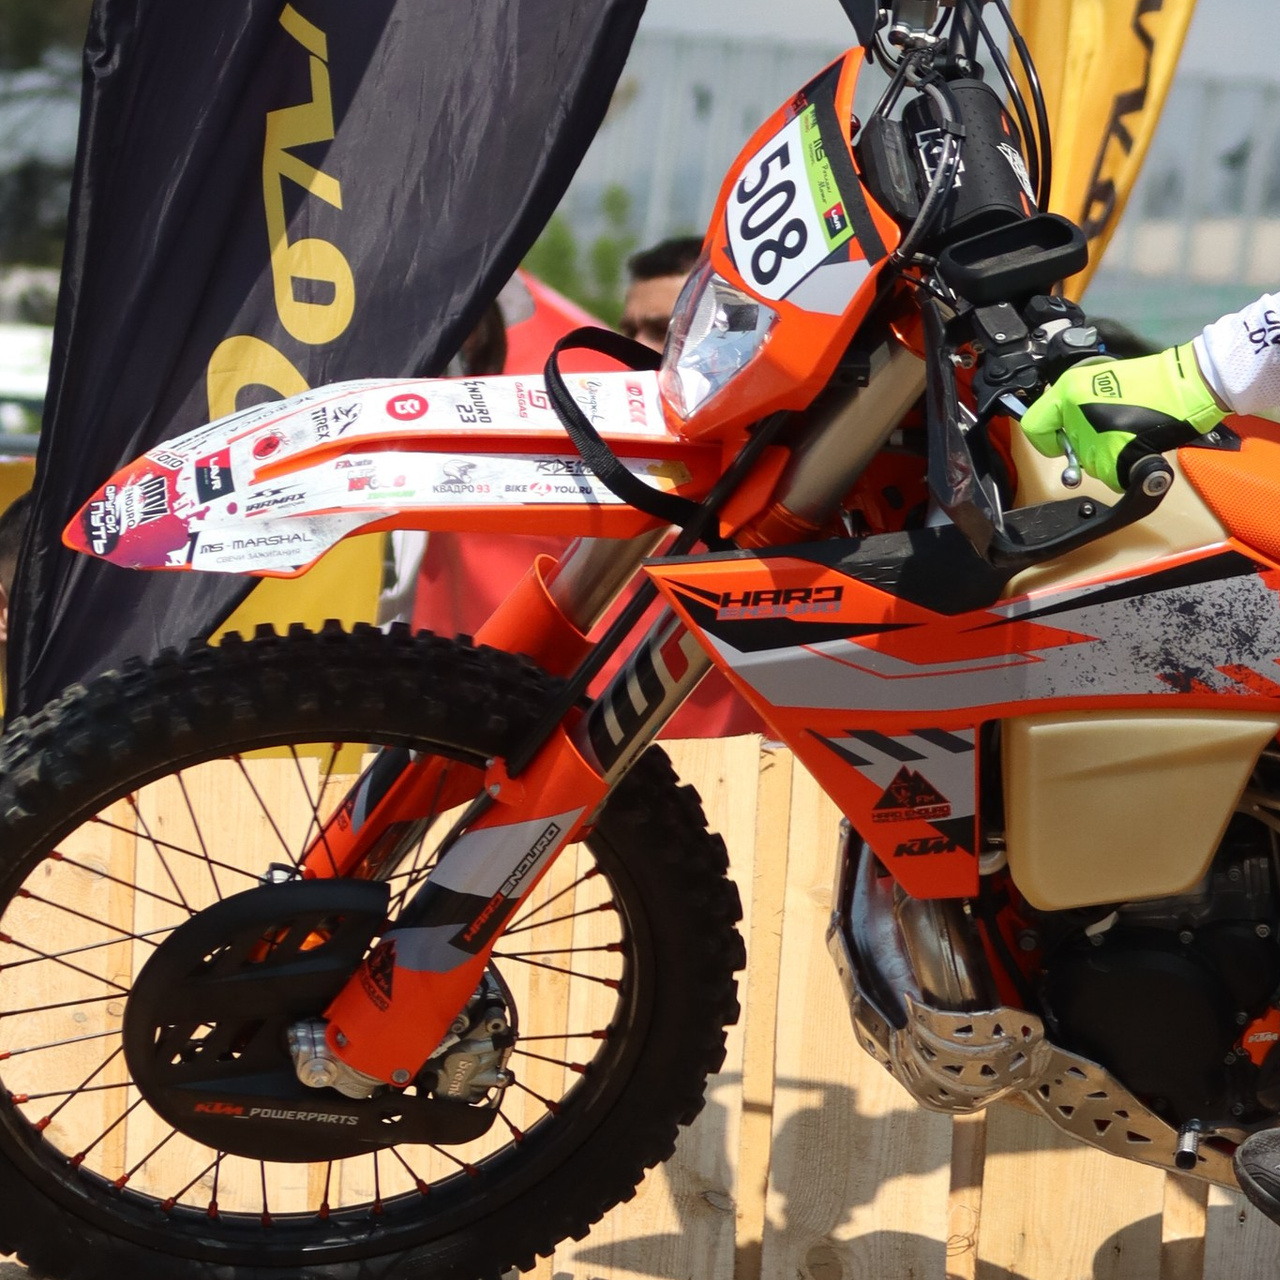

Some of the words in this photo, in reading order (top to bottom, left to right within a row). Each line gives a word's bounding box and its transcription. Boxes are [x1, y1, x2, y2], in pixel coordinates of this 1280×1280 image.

[736, 141, 808, 286] 508
[514, 381, 528, 418] GASGAS
[456, 404, 477, 424] 23
[208, 456, 223, 491] LAVR
[476, 484, 490, 493] 93
[505, 484, 527, 493] BIKE
[554, 484, 592, 495] YOU.RU
[91, 501, 109, 554] ПУТЬ
[720, 586, 844, 608] HARD
[716, 602, 842, 620] ENDURO
[893, 835, 957, 857] KTM
[501, 823, 562, 898] ENDURO
[463, 892, 504, 943] HARD
[1248, 1031, 1278, 1043] KTM
